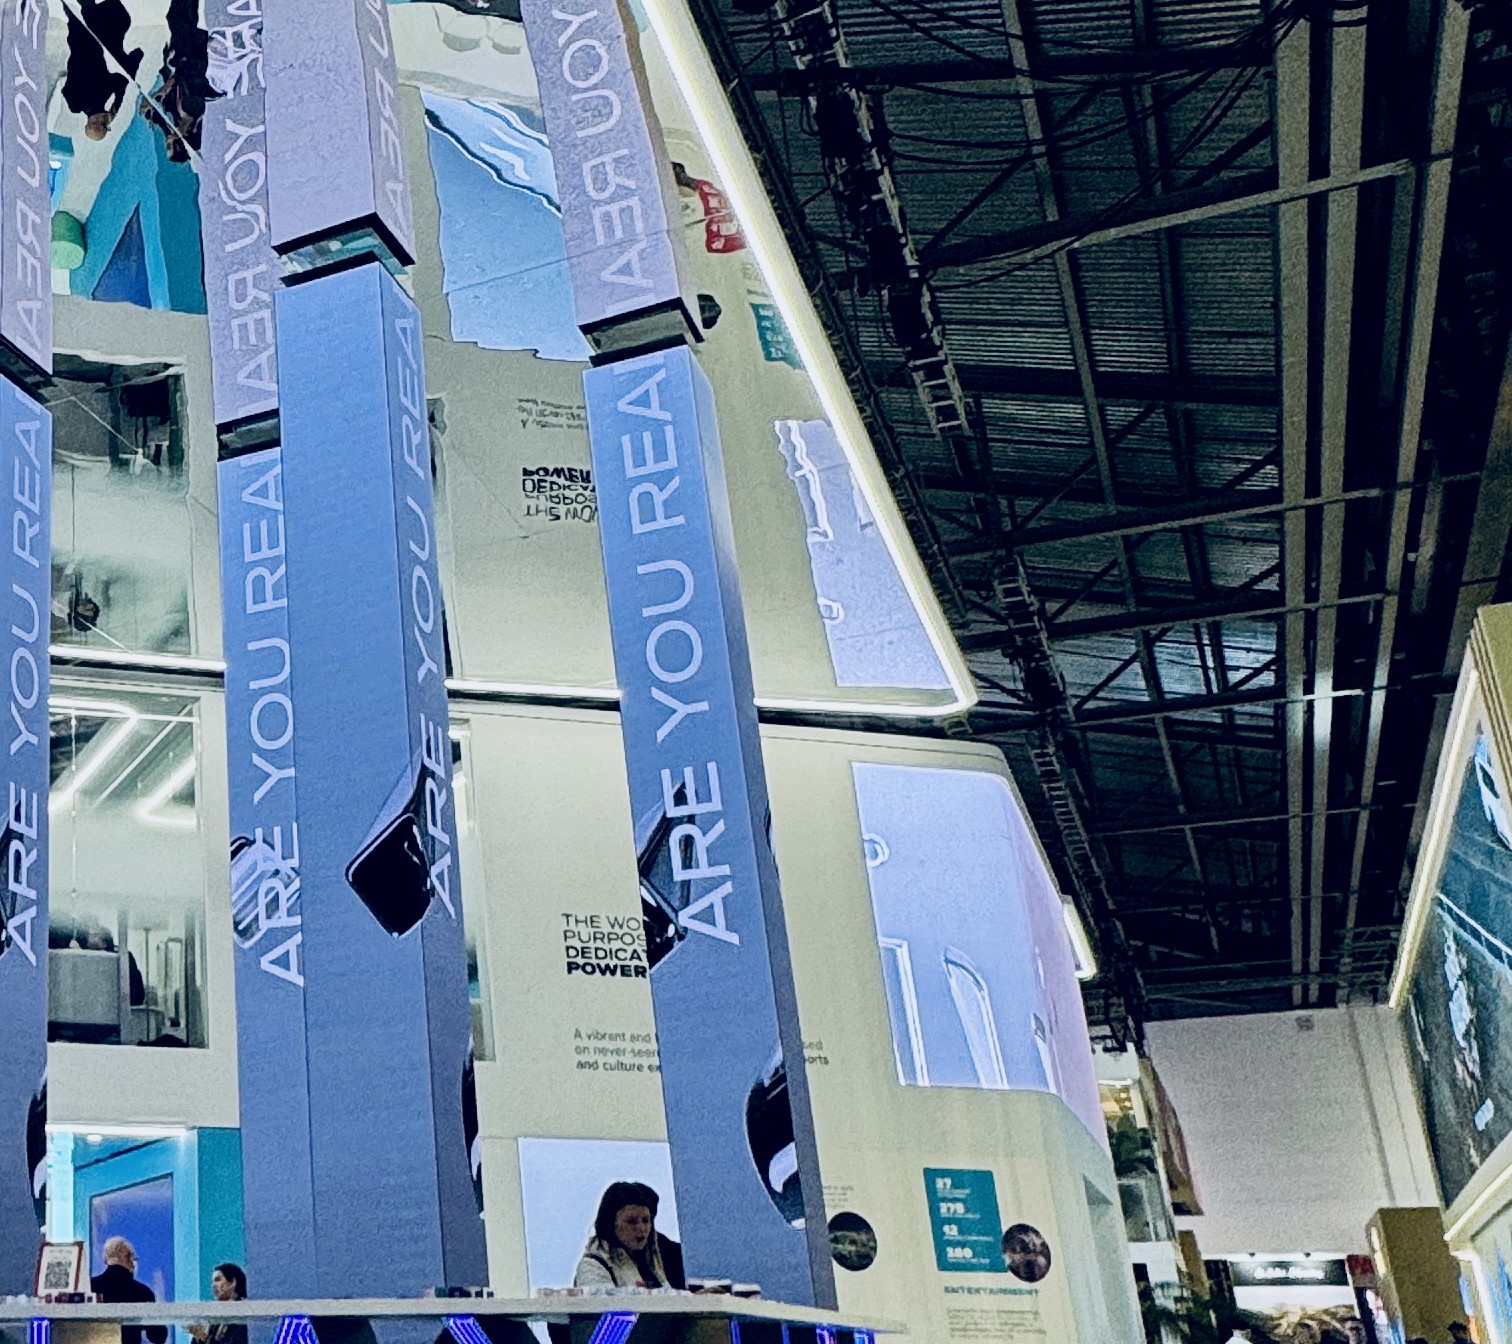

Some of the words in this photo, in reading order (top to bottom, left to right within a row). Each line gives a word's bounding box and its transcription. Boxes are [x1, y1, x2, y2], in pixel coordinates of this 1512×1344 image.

[9, 583, 40, 756] YOU
[406, 495, 438, 685] YOU
[636, 559, 710, 744] YOU
[246, 636, 296, 805] YOU
[6, 781, 39, 967] ARE
[420, 712, 456, 920] ARE
[660, 760, 741, 946] ARE
[254, 821, 305, 988] ARE
[561, 913, 602, 929] THE
[606, 915, 643, 931] WO
[565, 945, 648, 962] DEDICA
[574, 1027, 583, 1040] A
[586, 1029, 626, 1042] vibrant
[630, 1032, 652, 1044] and
[574, 1045, 590, 1056] on
[576, 1059, 599, 1071] and
[602, 1060, 645, 1073] culture
